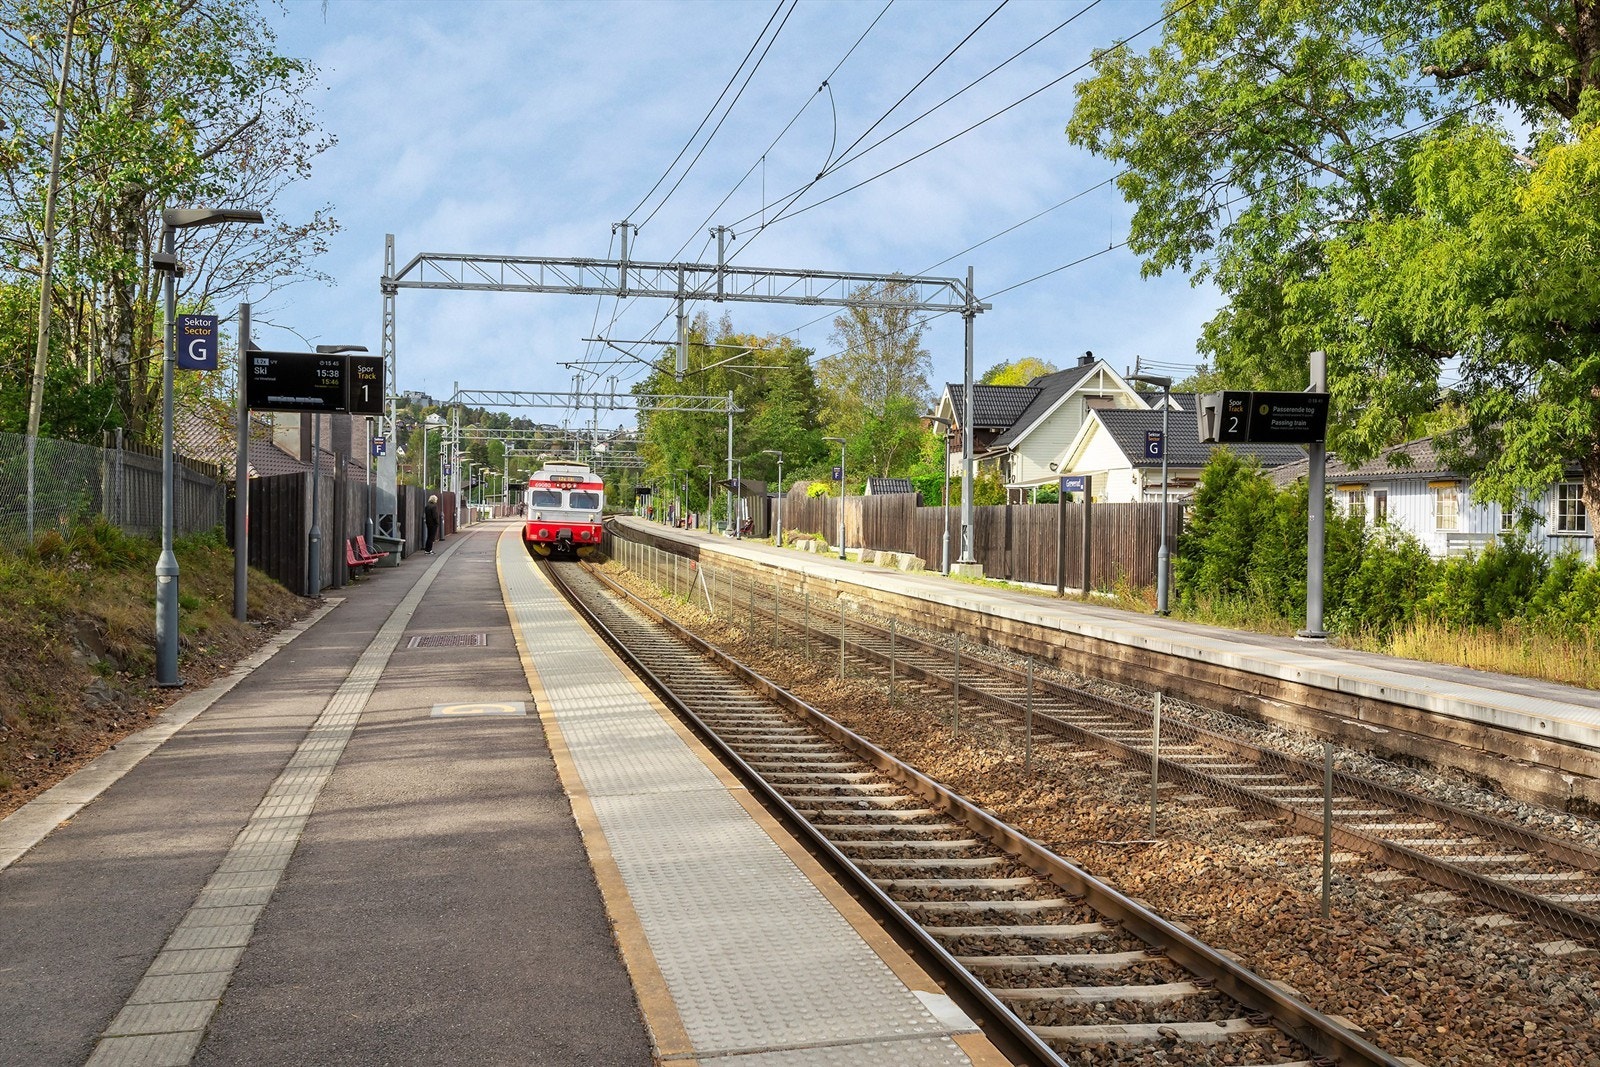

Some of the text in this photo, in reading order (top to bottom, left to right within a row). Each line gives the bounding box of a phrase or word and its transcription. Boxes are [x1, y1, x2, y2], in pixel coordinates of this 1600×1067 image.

[184, 317, 212, 327] Sektor
[184, 327, 212, 336] Sector
[188, 338, 207, 361] G
[254, 366, 267, 375] Ski
[357, 364, 374, 373] Spor
[316, 369, 340, 378] 15:38
[357, 372, 377, 380] Track
[361, 384, 369, 402] 1
[1228, 416, 1238, 433] 2
[1271, 418, 1294, 427] Passing
[376, 445, 382, 453] F
[1149, 442, 1158, 454] G
